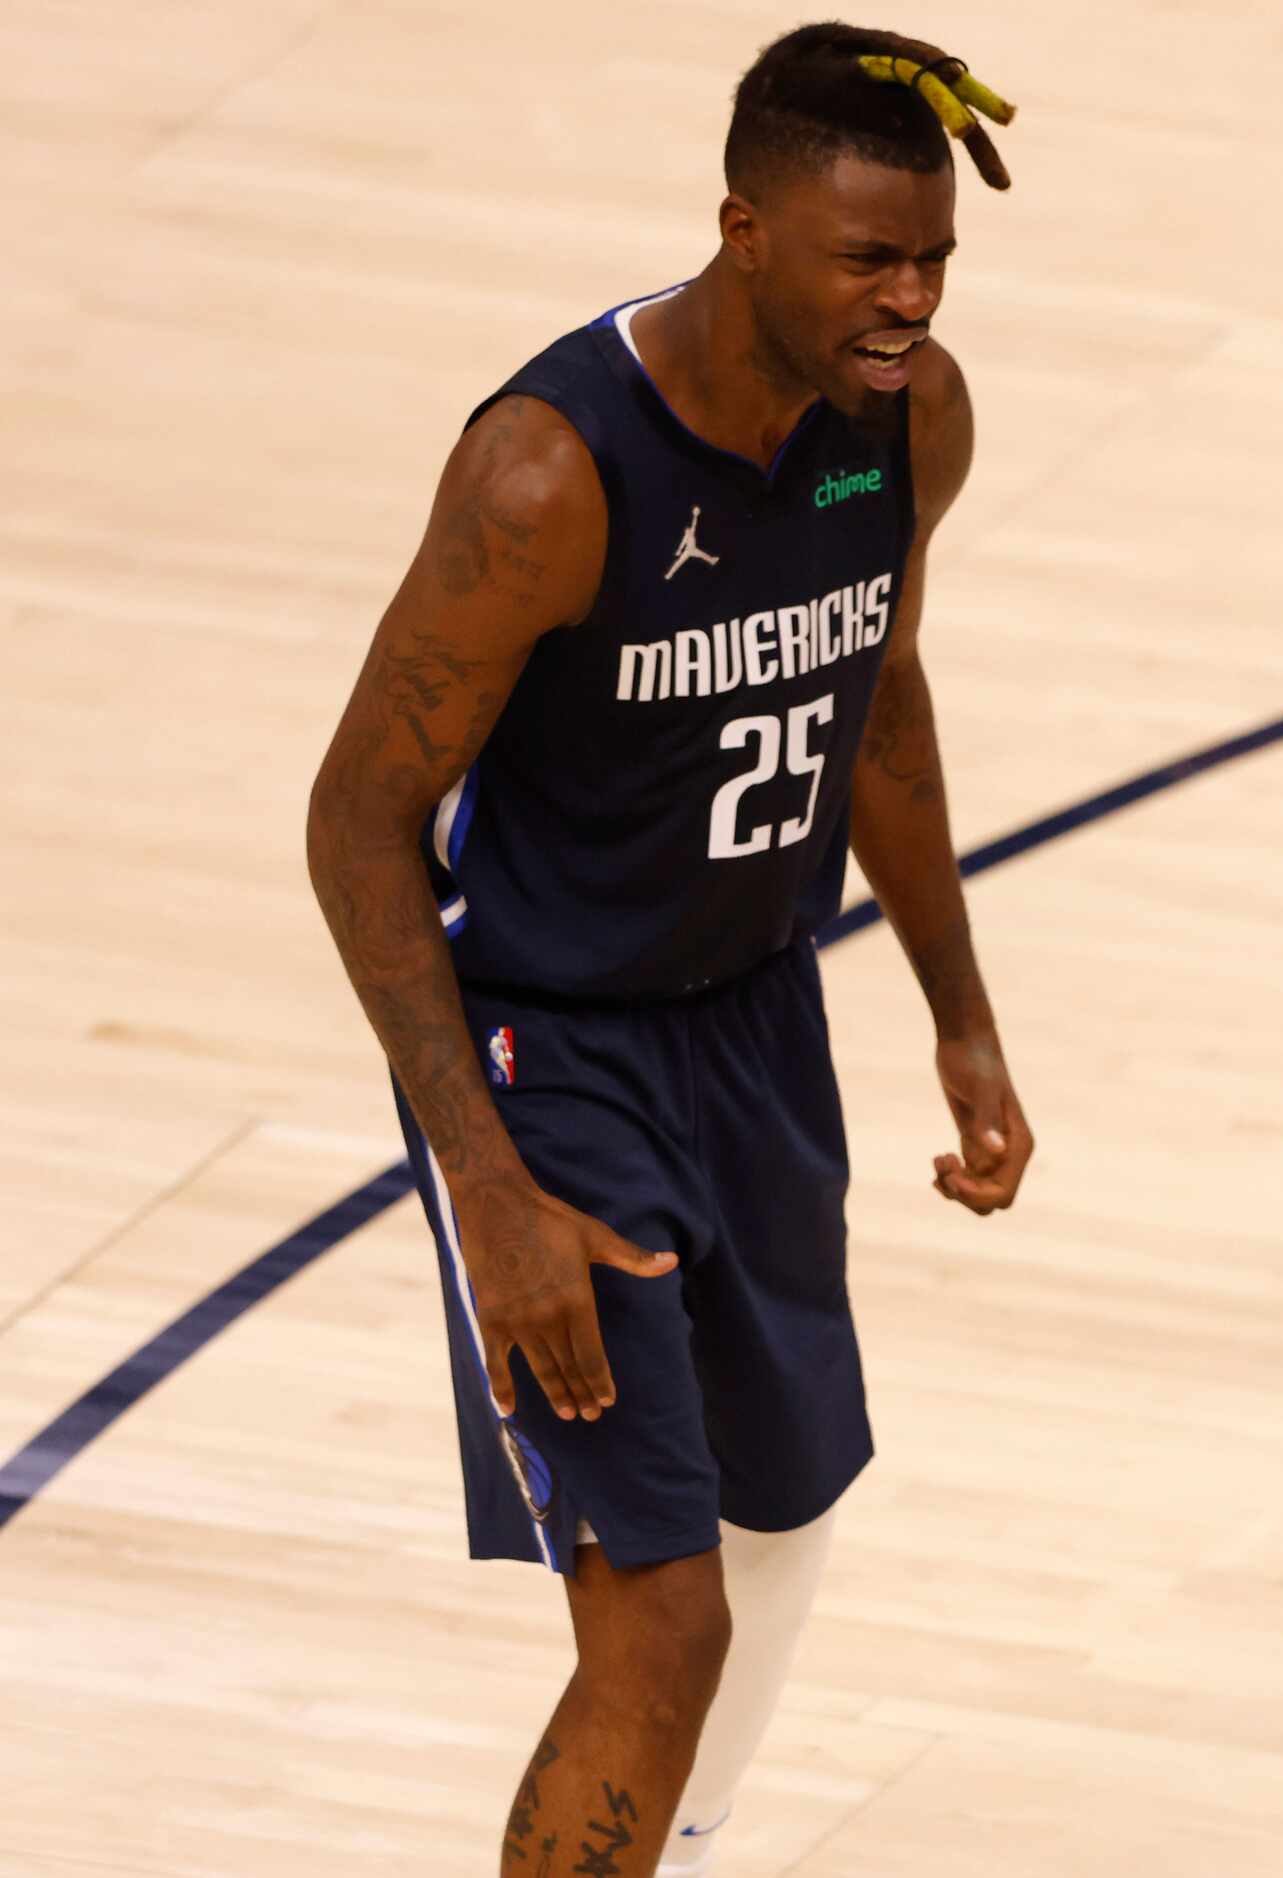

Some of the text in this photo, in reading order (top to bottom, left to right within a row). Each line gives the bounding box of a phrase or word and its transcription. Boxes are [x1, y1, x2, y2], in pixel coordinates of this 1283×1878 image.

[814, 468, 883, 508] chime
[615, 572, 893, 702] MAVERICKS
[707, 693, 835, 860] 25
